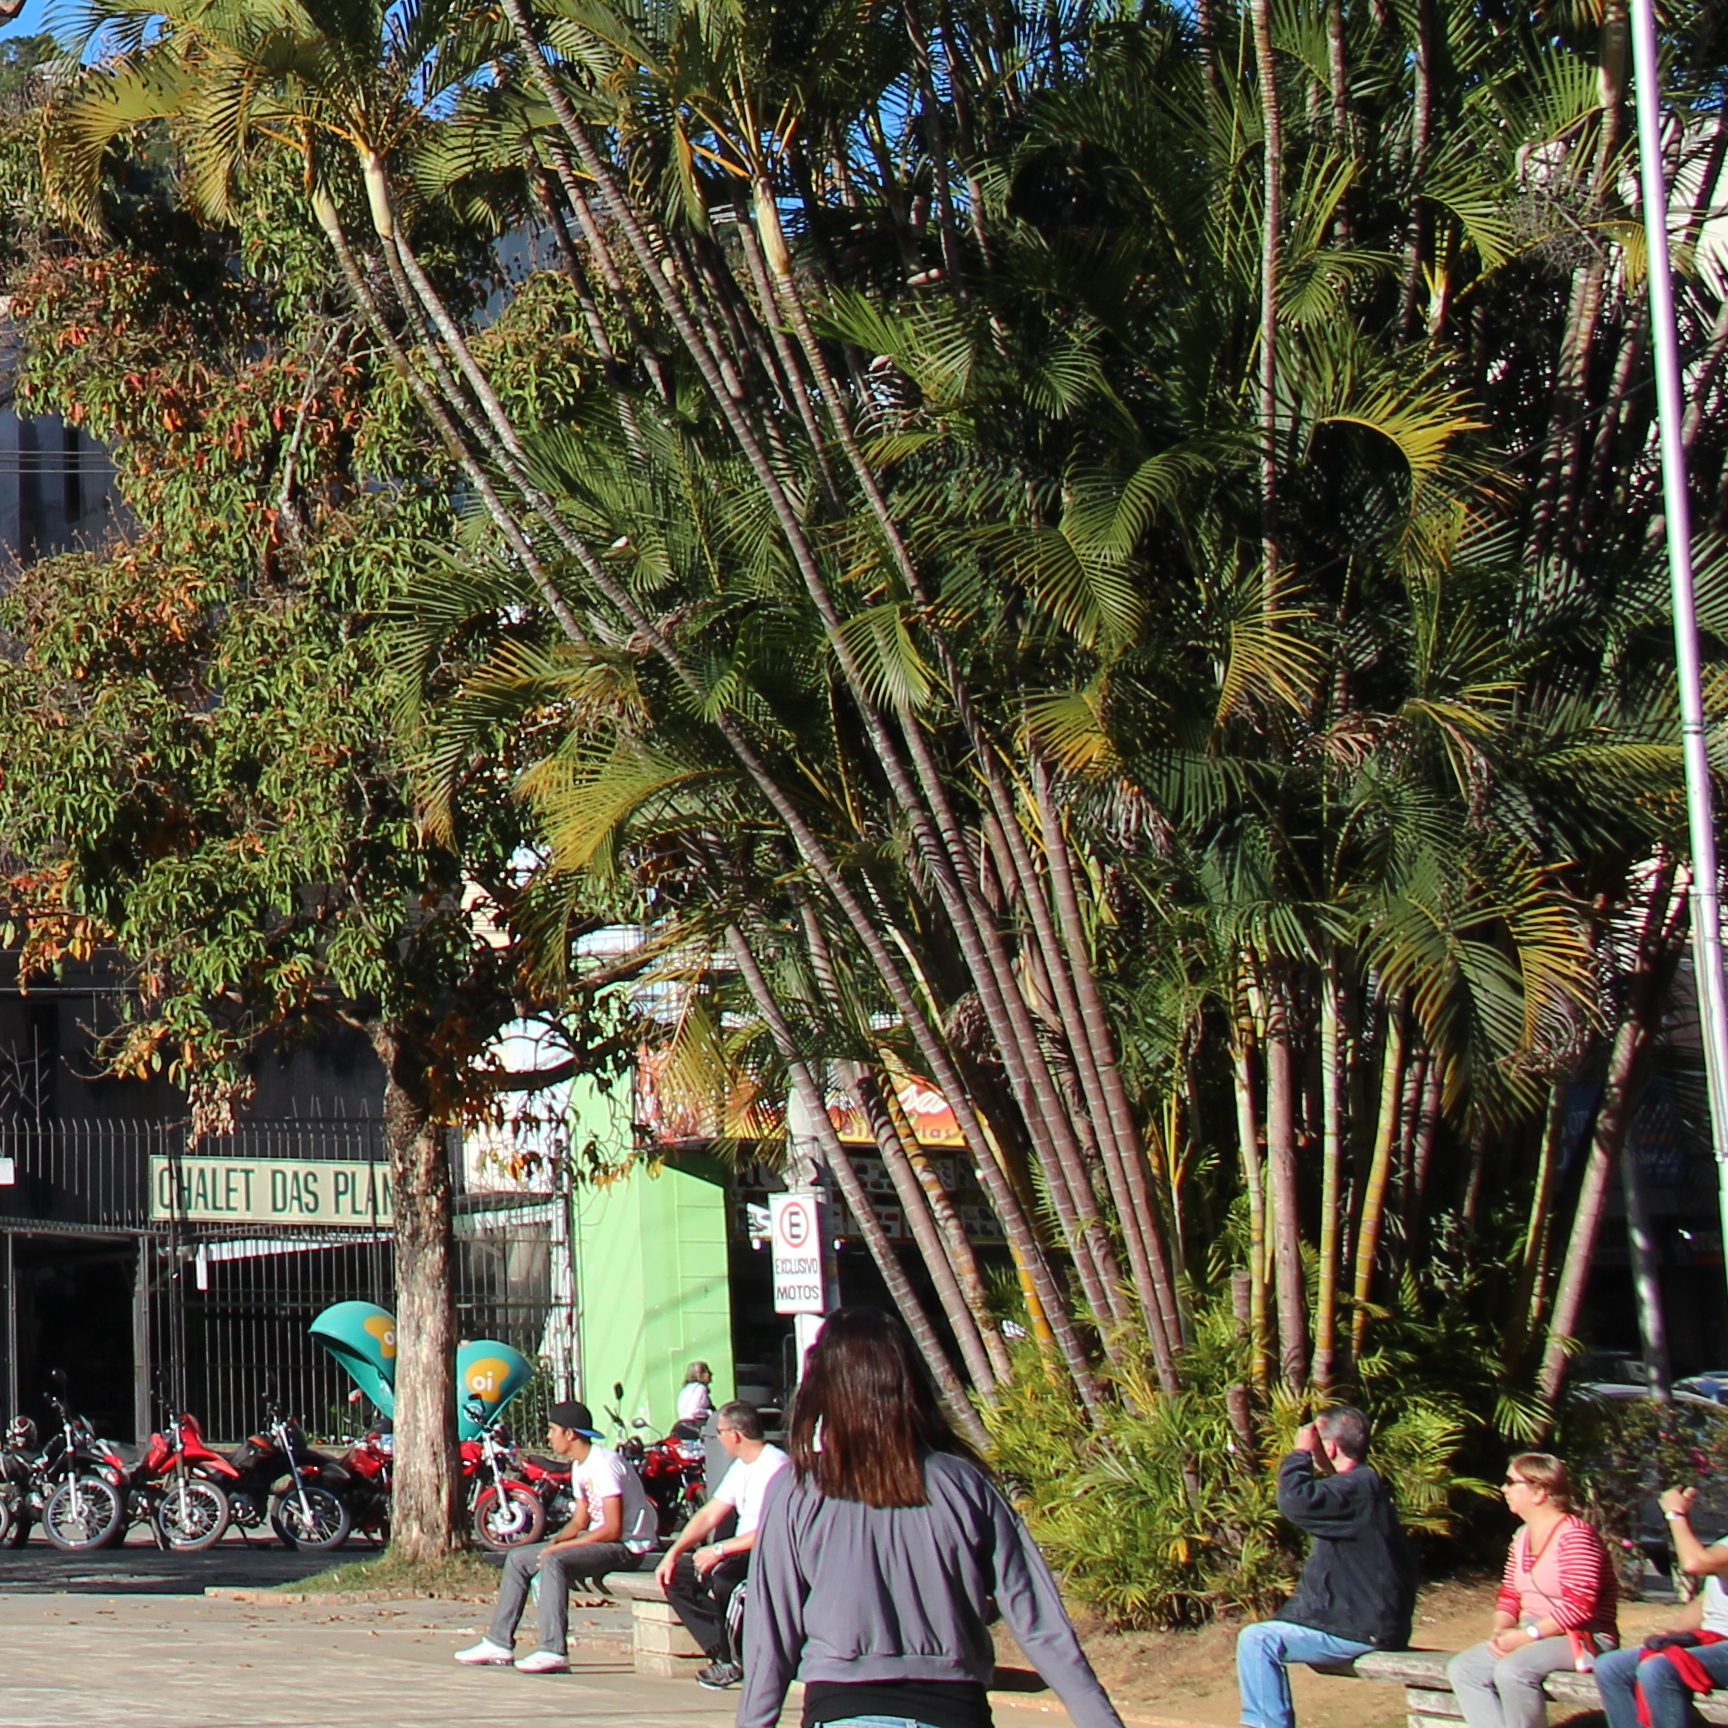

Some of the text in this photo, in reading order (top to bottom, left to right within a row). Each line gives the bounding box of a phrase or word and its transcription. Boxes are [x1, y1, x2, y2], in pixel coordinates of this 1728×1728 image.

[159, 1166, 394, 1216] CHALET DAS PLAN
[789, 1210, 802, 1240] E
[775, 1258, 818, 1275] EXCLUSIVO
[776, 1285, 820, 1300] MOTOS
[472, 1370, 493, 1391] oi
